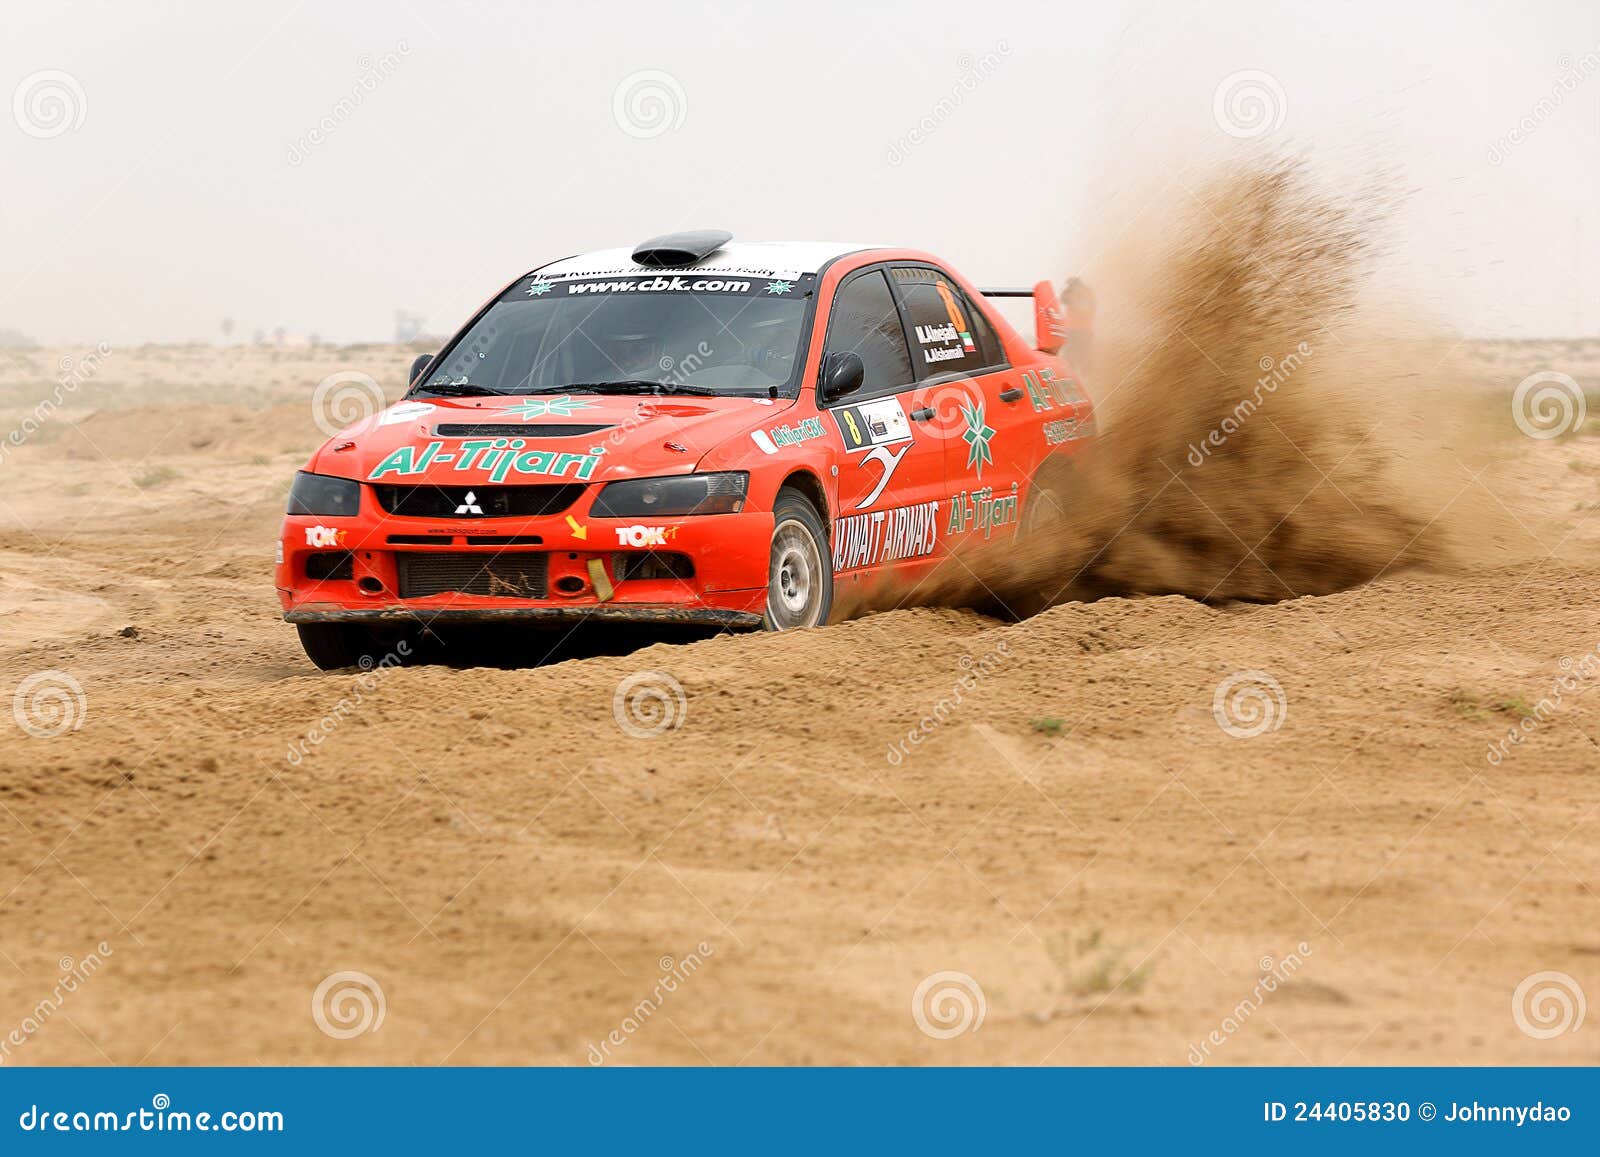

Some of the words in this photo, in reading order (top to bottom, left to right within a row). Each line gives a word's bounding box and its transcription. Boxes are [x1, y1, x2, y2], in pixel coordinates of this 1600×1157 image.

[568, 276, 751, 294] www.cbk.com
[936, 280, 967, 333] 8
[843, 410, 862, 446] 8
[367, 438, 606, 483] Al-Tijari
[947, 481, 1019, 540] Al-Tijari
[833, 512, 885, 571] KUWAIT
[880, 501, 940, 562] AIRWAYS
